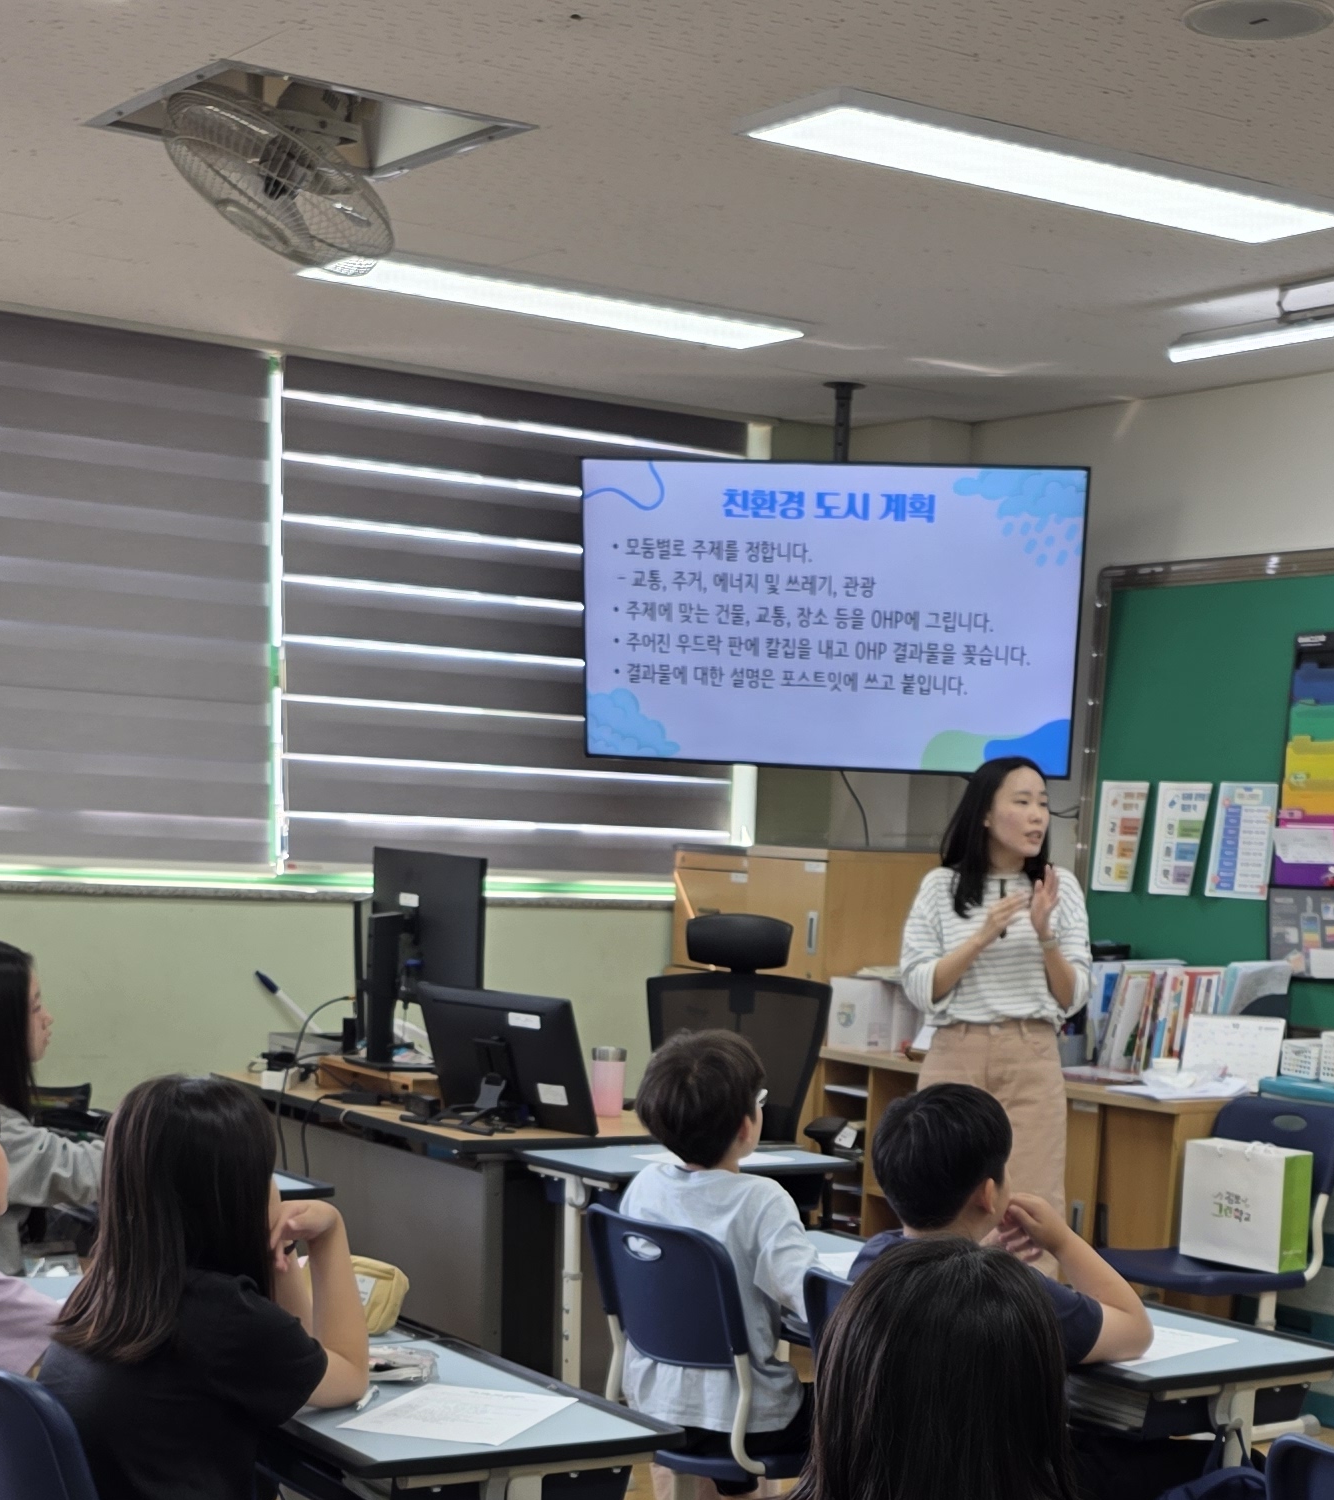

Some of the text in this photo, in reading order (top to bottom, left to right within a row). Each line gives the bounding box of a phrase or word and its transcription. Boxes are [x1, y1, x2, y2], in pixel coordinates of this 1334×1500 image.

[723, 487, 937, 523] 친환경 도시 계획
[625, 538, 813, 564] 모둠별로 주제를 정합니다.
[632, 569, 876, 599] 교통, 주거, 에너지 및 쓰레기, 관광
[625, 601, 994, 633] 주제에 맞는 건물, 교통, 장소 등을 OHP에 그립니다.
[626, 633, 1031, 666] 주어진 우드락 판에 칼집을 내고 OHP 결과물을 꽂습니다.
[626, 663, 968, 696] 결과물에 대한 설명은 포스트잇에 쓰고 붙입니다.
